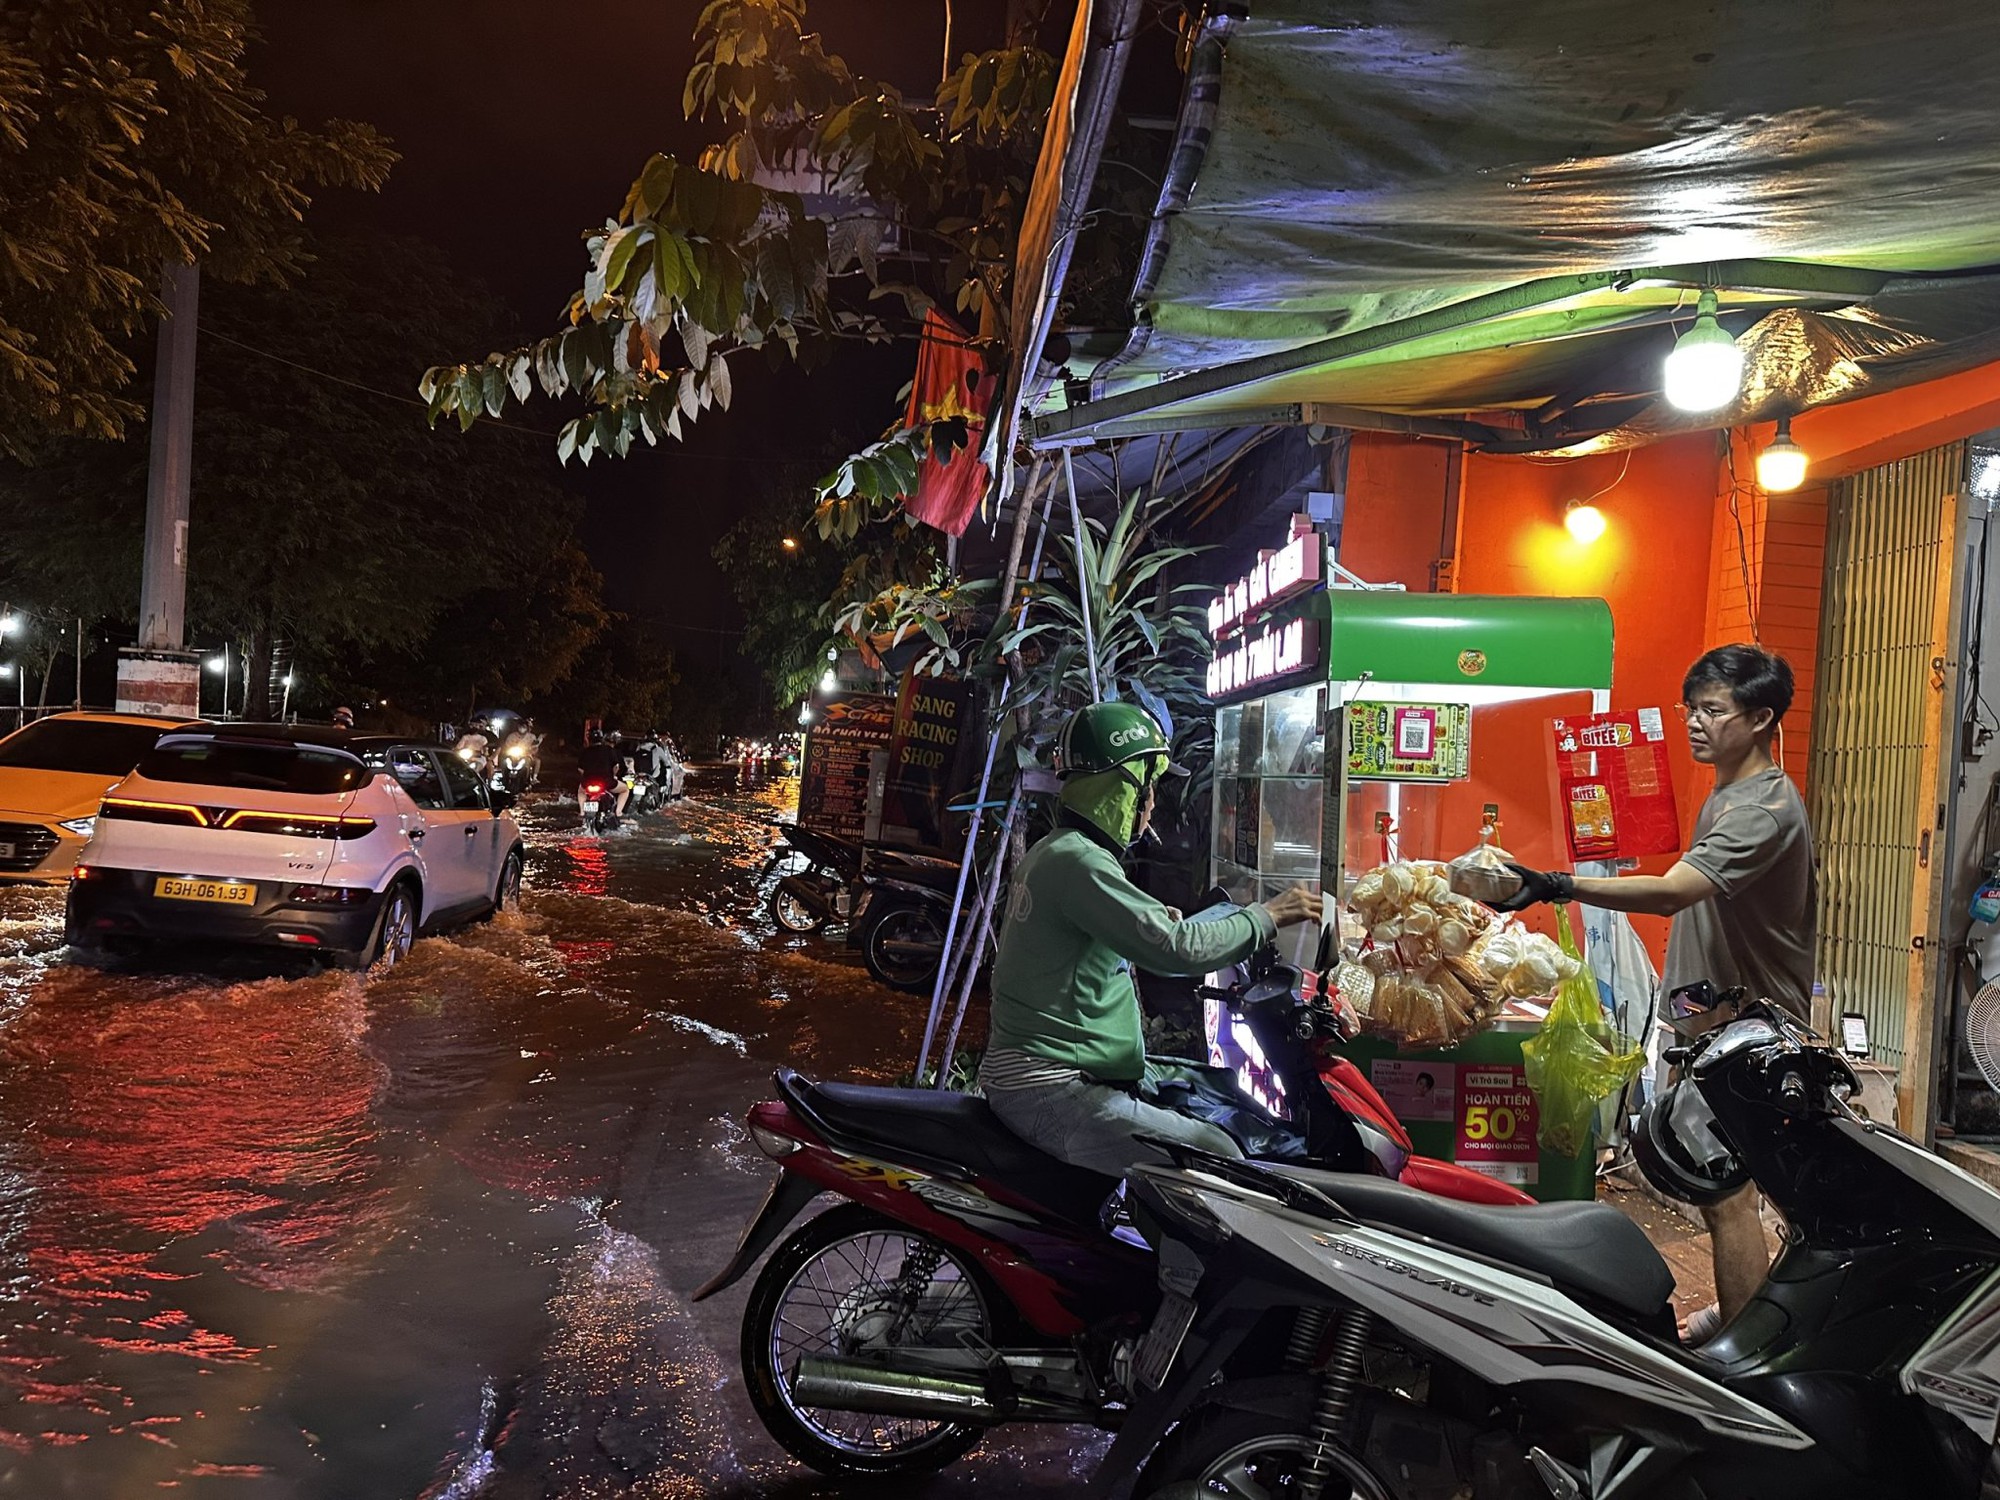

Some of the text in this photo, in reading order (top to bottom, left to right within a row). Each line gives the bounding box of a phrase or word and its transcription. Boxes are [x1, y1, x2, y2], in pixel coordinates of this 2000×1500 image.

[911, 695, 957, 718] SANG
[898, 721, 957, 746] RACING
[1109, 722, 1150, 747] Grab
[900, 746, 944, 769] SHOP
[163, 881, 248, 901] 63H-061.93
[1465, 1092, 1501, 1107] HOÀN
[1464, 1142, 1480, 1150] CHO
[1480, 1142, 1494, 1152] MỌI
[1512, 1143, 1530, 1152] DỊCH
[1384, 1258, 1499, 1306] BLADE
